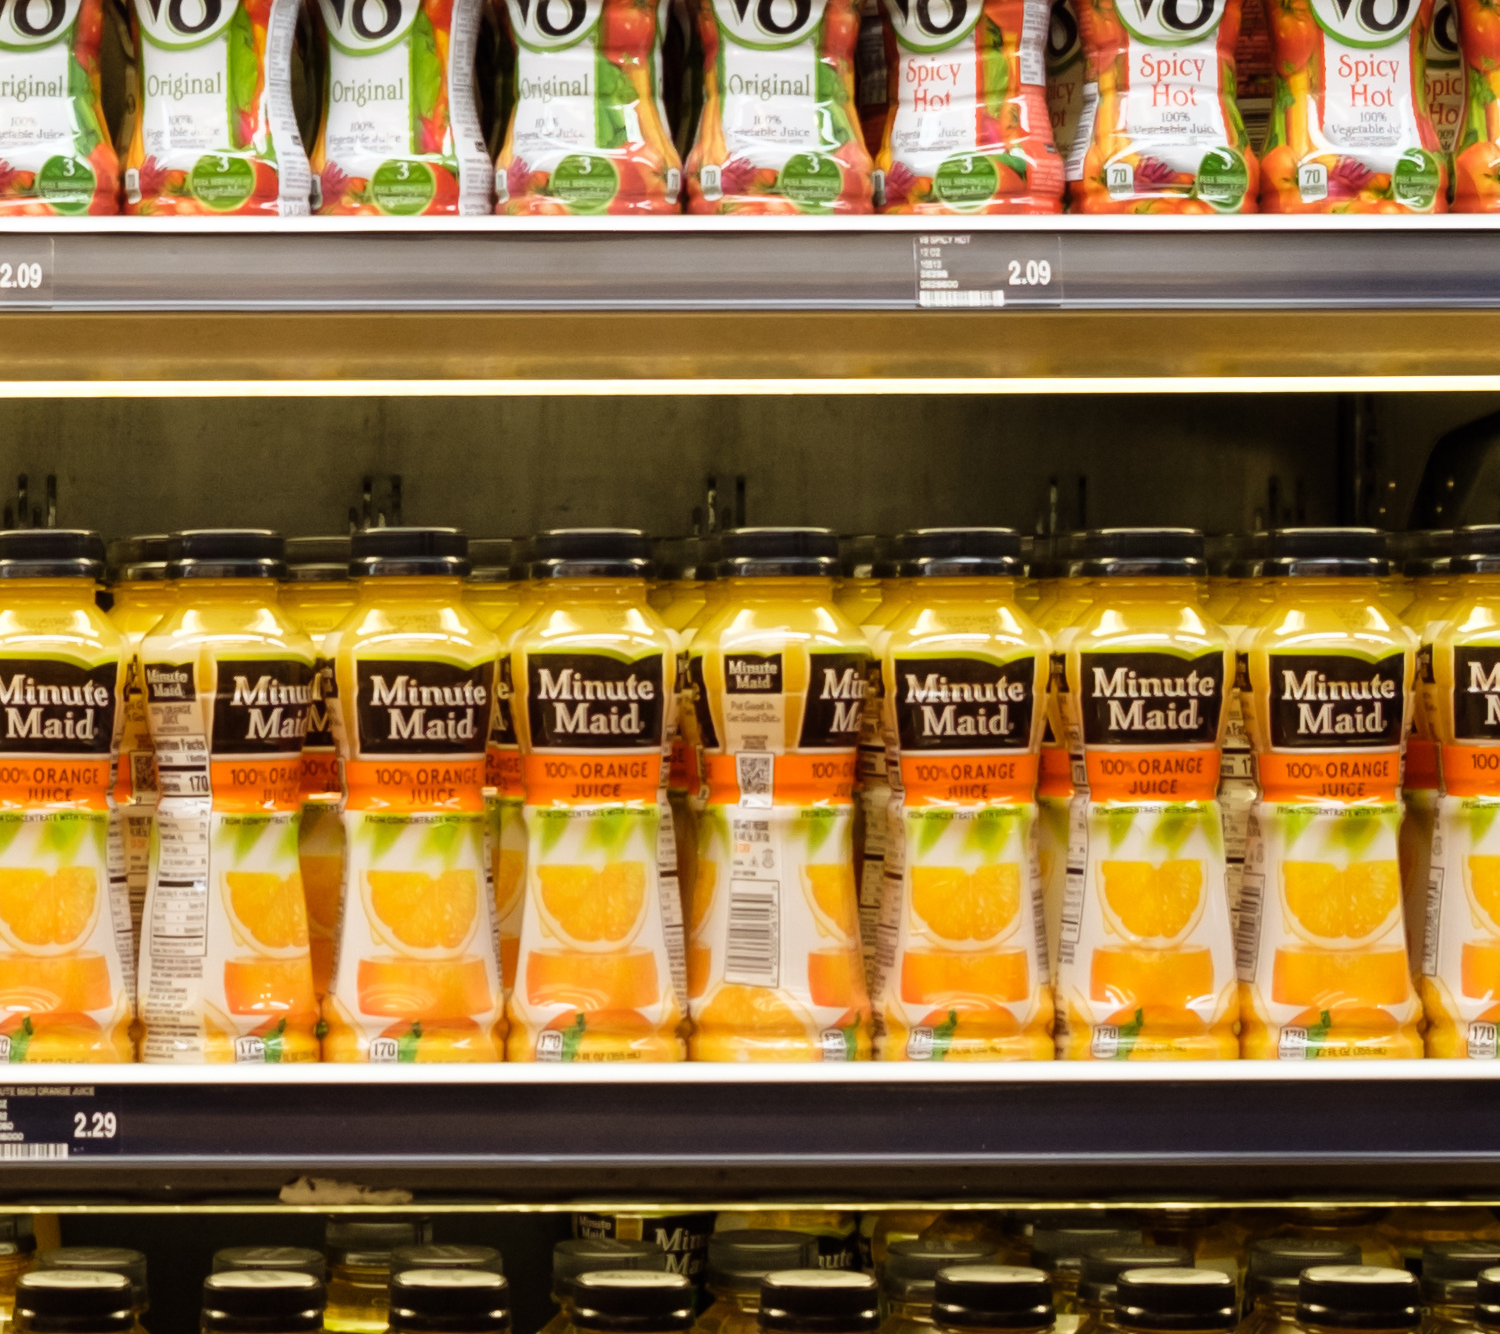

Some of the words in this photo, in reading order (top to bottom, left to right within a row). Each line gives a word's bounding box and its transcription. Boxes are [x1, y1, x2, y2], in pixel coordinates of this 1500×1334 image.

[1337, 52, 1401, 88] Spicy
[1349, 80, 1396, 109] Hot
[0, 264, 42, 289] 2.09
[1008, 261, 1051, 286] 2.09
[73, 1112, 117, 1138] 2.29
